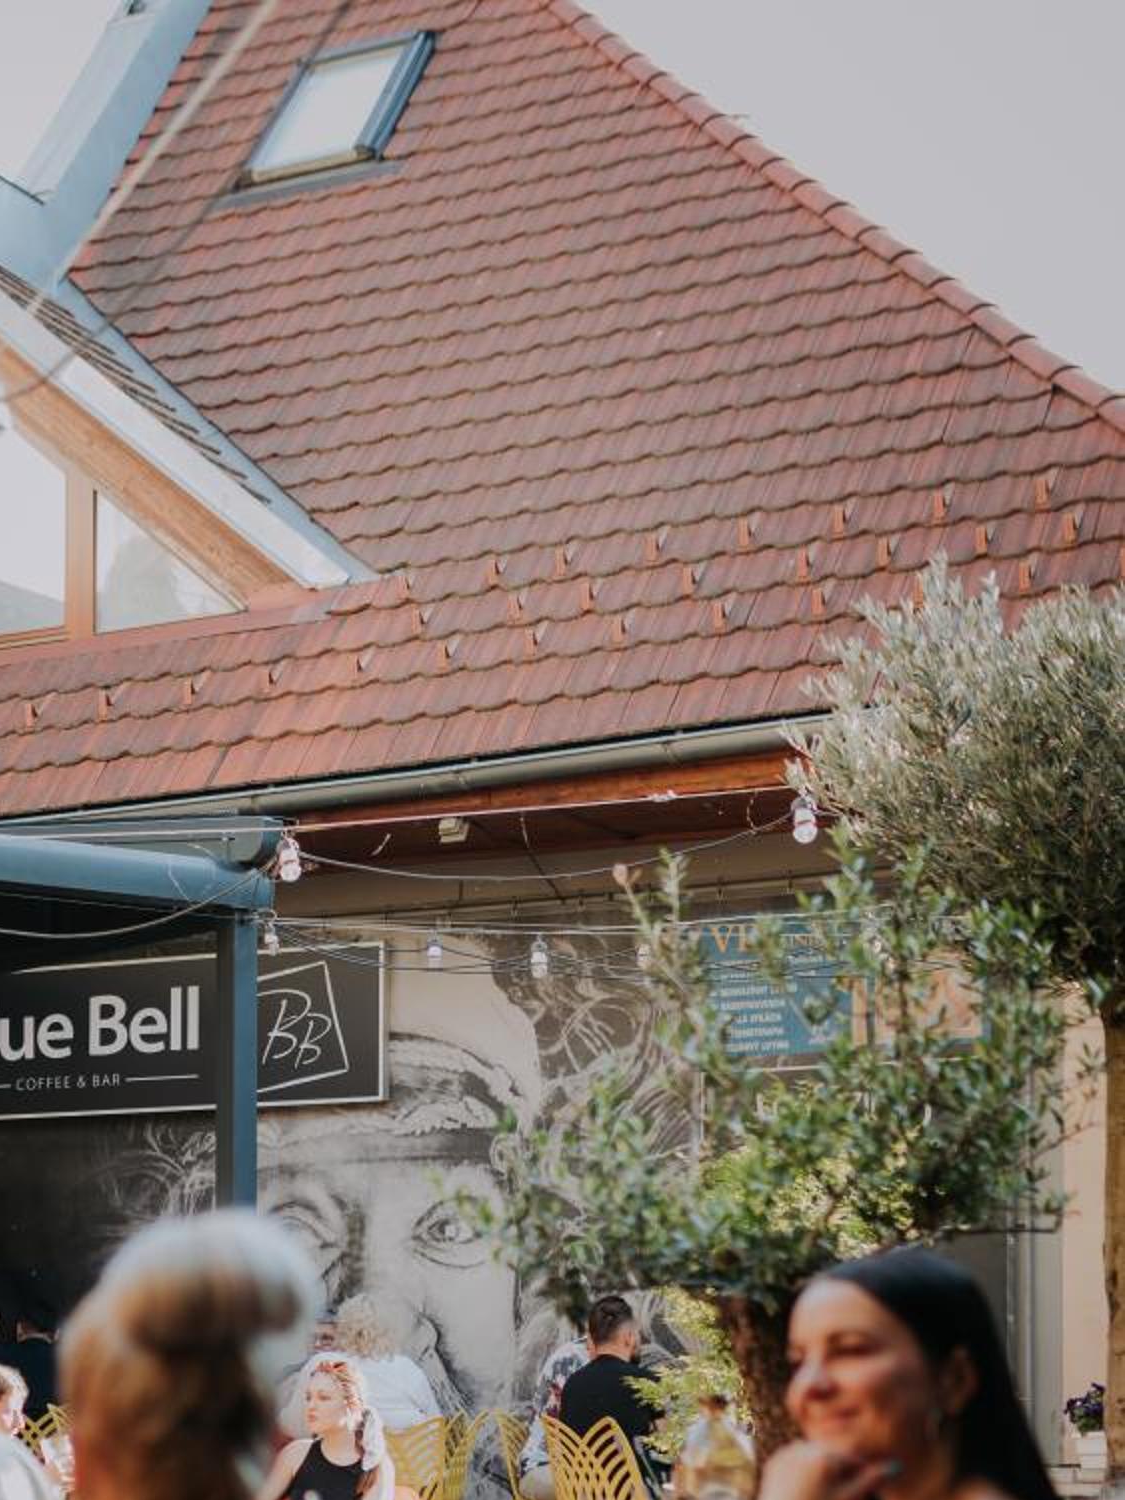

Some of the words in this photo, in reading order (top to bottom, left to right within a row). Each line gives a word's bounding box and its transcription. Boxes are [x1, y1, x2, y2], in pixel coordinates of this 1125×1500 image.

[88, 985, 200, 1057] Bell
[15, 1075, 72, 1091] COFFEE
[76, 1074, 87, 1089] &
[92, 1072, 121, 1088] BAR
